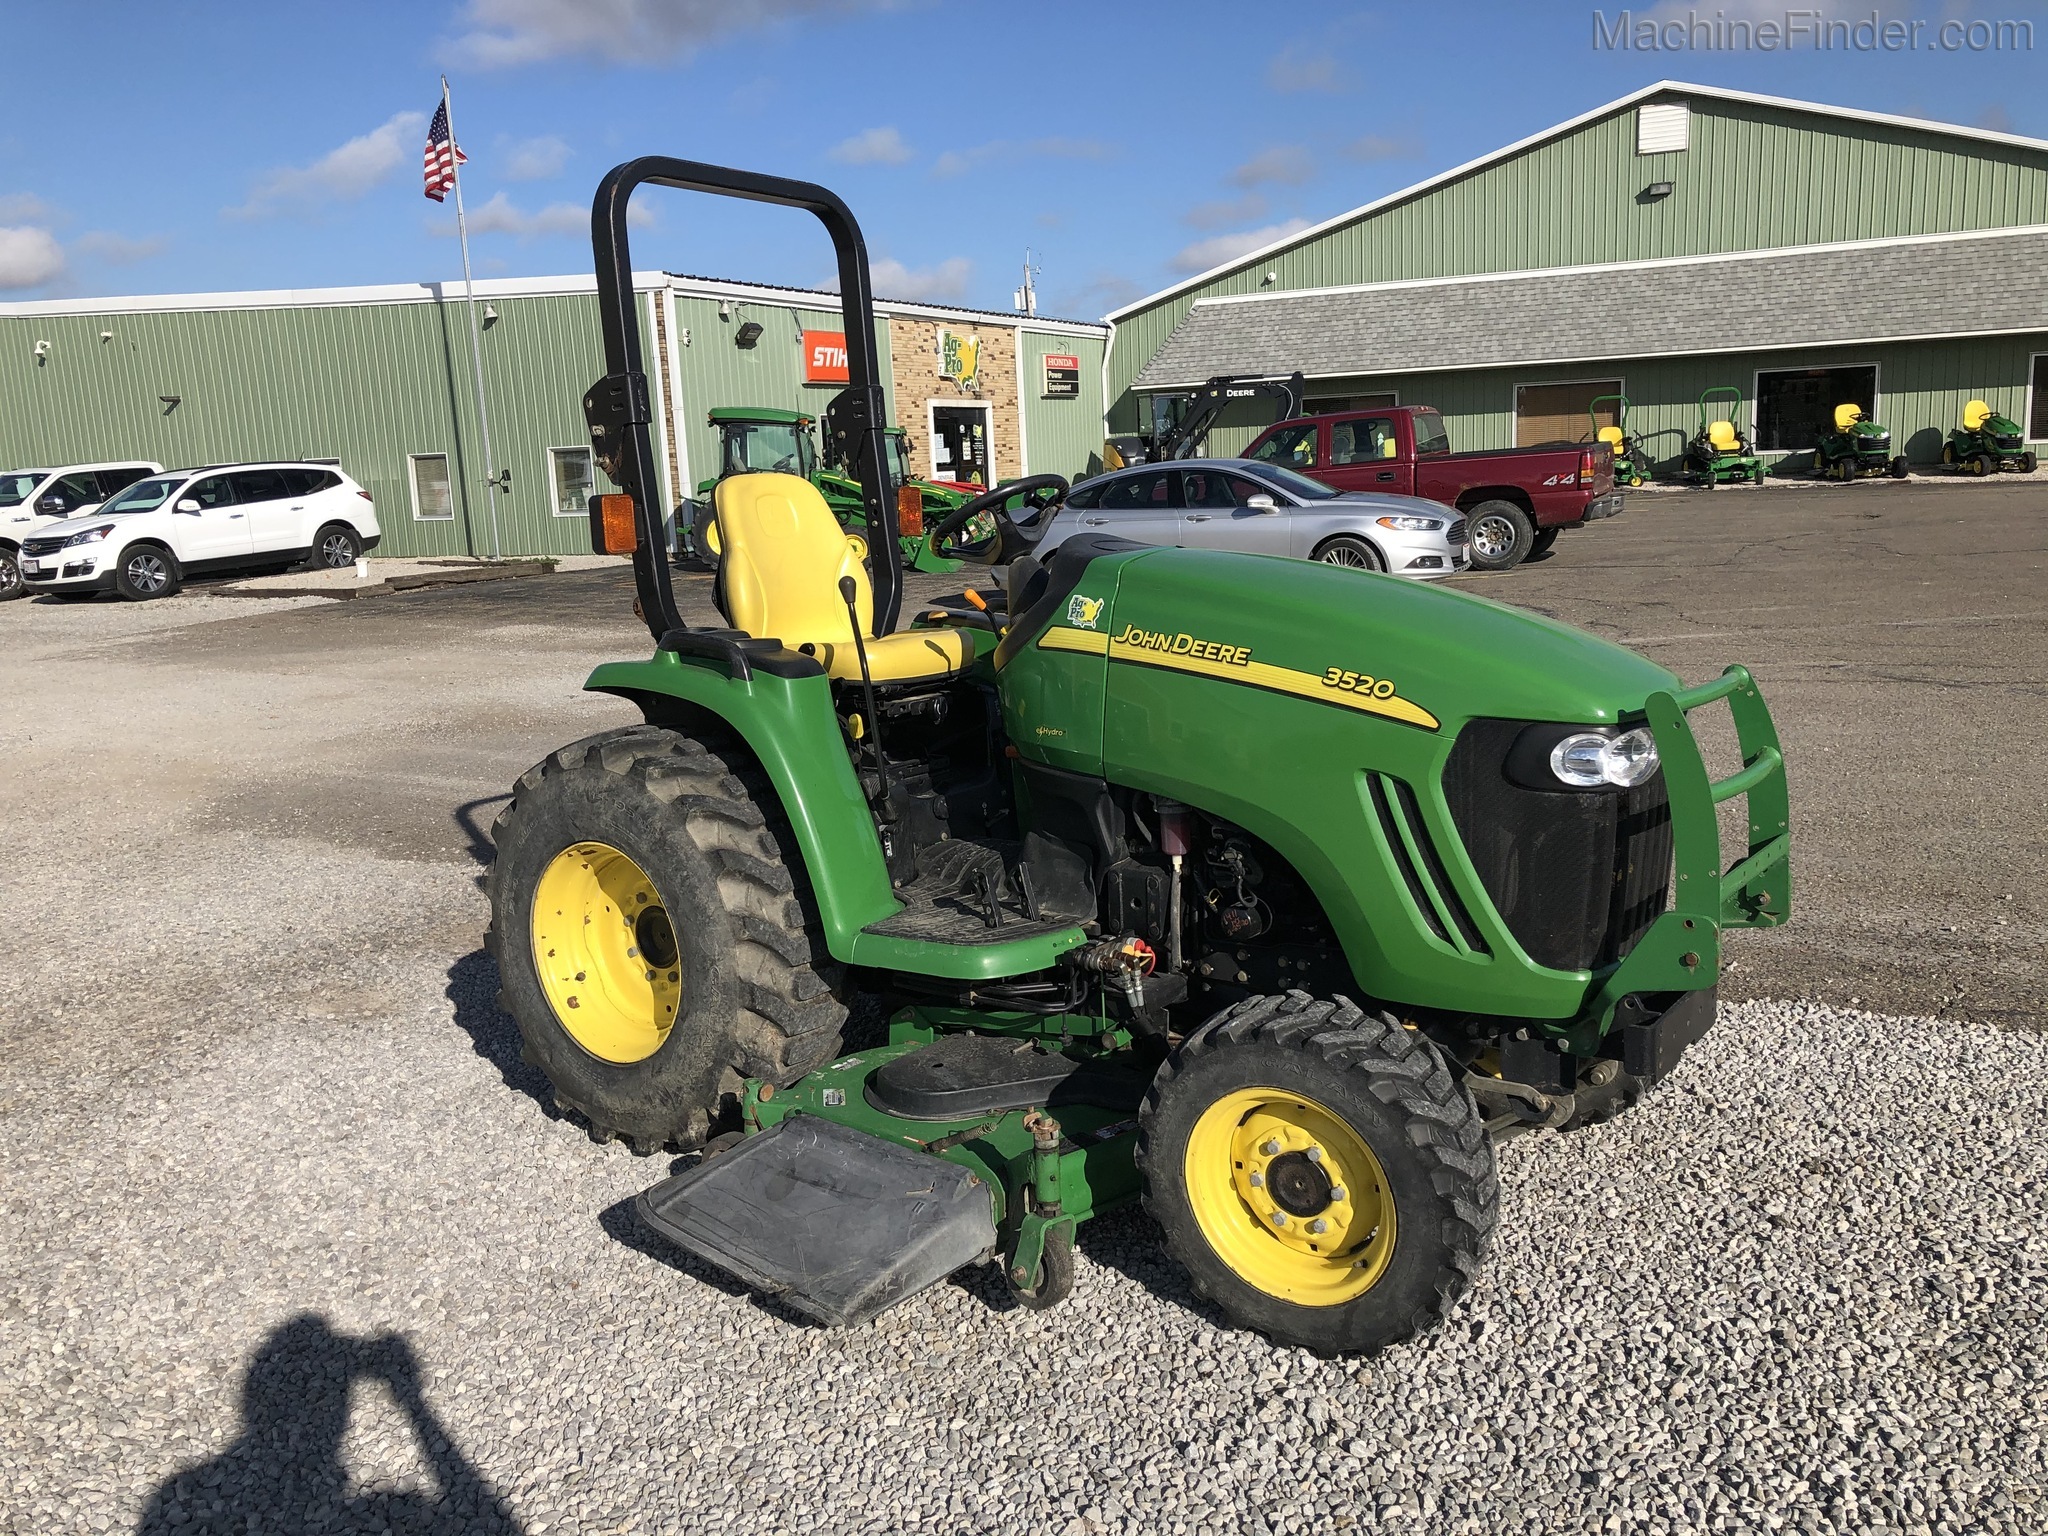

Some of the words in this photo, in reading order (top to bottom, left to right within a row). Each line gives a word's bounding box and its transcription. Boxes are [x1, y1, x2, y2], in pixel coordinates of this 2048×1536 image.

[813, 347, 848, 367] STIH
[1047, 357, 1073, 367] HONDA
[944, 354, 962, 374] Pro
[1048, 370, 1063, 379] Power
[1049, 382, 1072, 392] Equipment
[1226, 389, 1255, 397] DEERE
[1070, 607, 1085, 618] Pro
[1114, 624, 1173, 650] JOHN
[1172, 633, 1252, 665] DEERE
[1322, 667, 1395, 699] 3520
